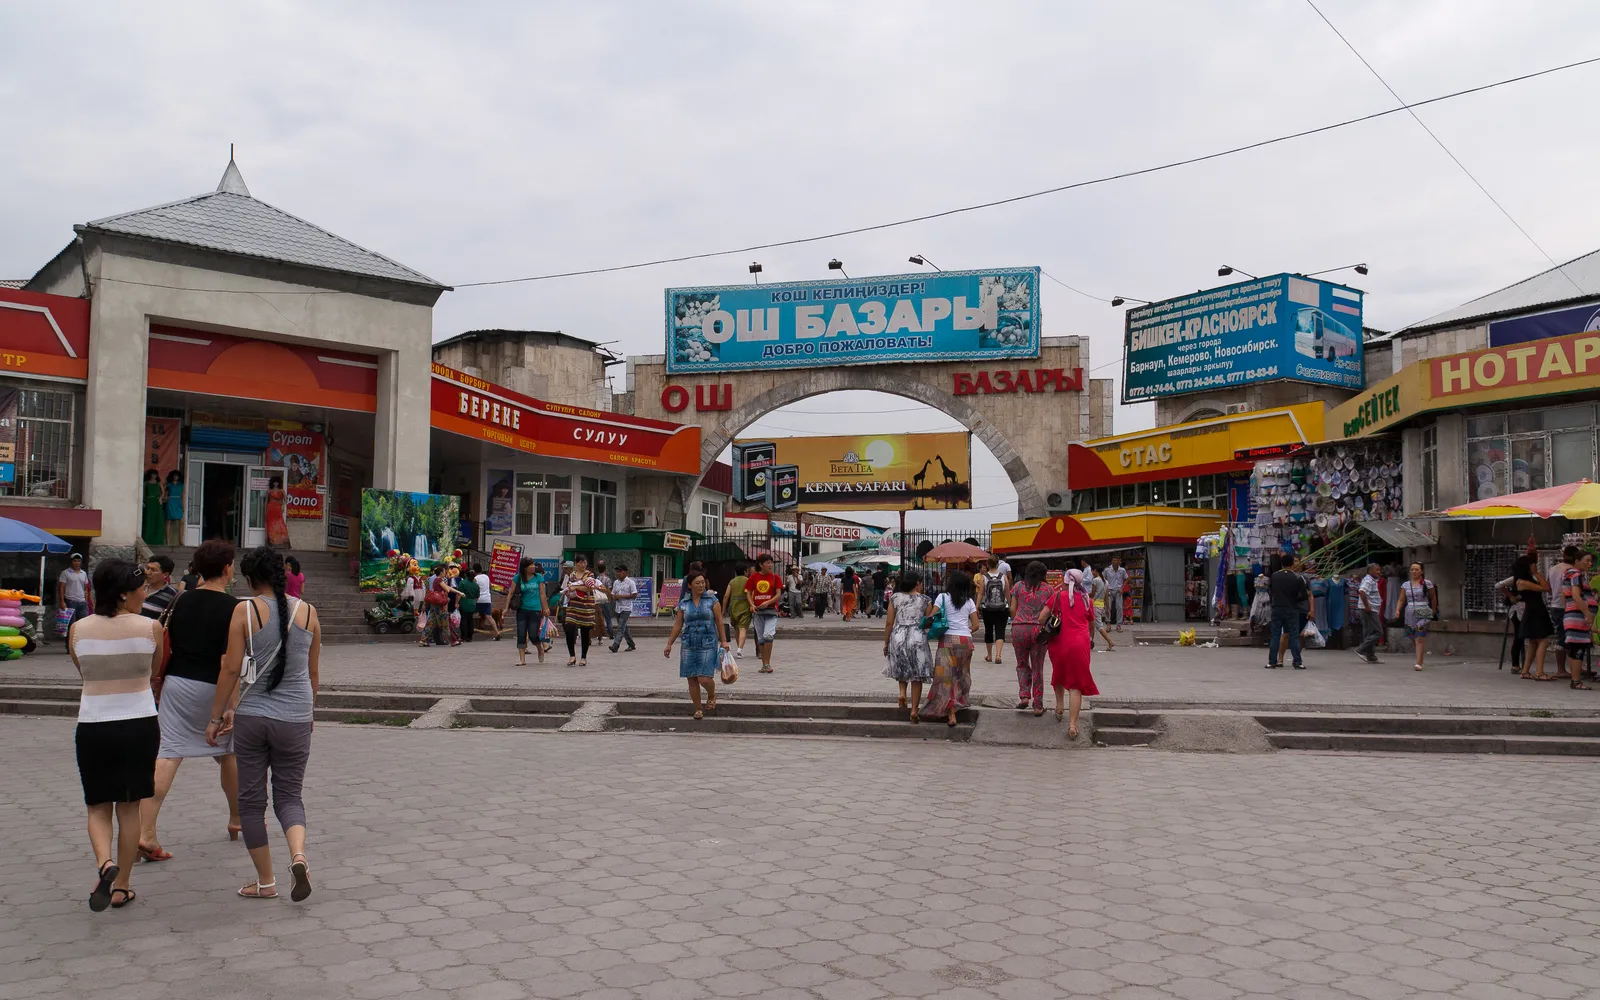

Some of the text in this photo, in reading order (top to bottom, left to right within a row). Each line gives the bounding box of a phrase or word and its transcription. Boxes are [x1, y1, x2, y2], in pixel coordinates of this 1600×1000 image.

[771, 282, 926, 304] КОШ КЕЛИҢИЗДЕР!
[1154, 301, 1172, 314] автобус
[1240, 282, 1261, 294] аралык
[1263, 278, 1281, 289] ташуу
[702, 296, 998, 344] ОШ БАЗАРЫ
[1131, 300, 1278, 352] БИШКЕК-КРАСНОЯРСК
[763, 335, 932, 358] ДОБРО ПОЖАЛОВАТЬ!
[1130, 338, 1278, 374] Барнаул, Кемерово, Новосибирск.
[1178, 338, 1222, 352] через города
[431, 364, 490, 391] СООДА БОРБОРУ
[1167, 359, 1233, 378] шаарлары аркылуу
[1296, 364, 1342, 382] Счастливого
[952, 368, 1084, 396] БАЗАРЫ
[1129, 386, 1145, 397] 0772
[1176, 379, 1193, 390] 0773
[1227, 371, 1244, 383] 0777
[662, 384, 732, 412] ОШ
[458, 392, 520, 430] БЕРЕКЕ
[546, 403, 601, 419] СУЛУУЛУК САЛОНУ
[483, 428, 536, 450] ТОРГОВЫЙ ЦЕНТР
[573, 428, 628, 446] СУЛУУ
[609, 454, 657, 466] САЛОН КРАСОТЫ
[1119, 443, 1172, 468] СТАС
[830, 463, 872, 474] BETA TEA
[805, 480, 906, 493] KENYA SAFARI
